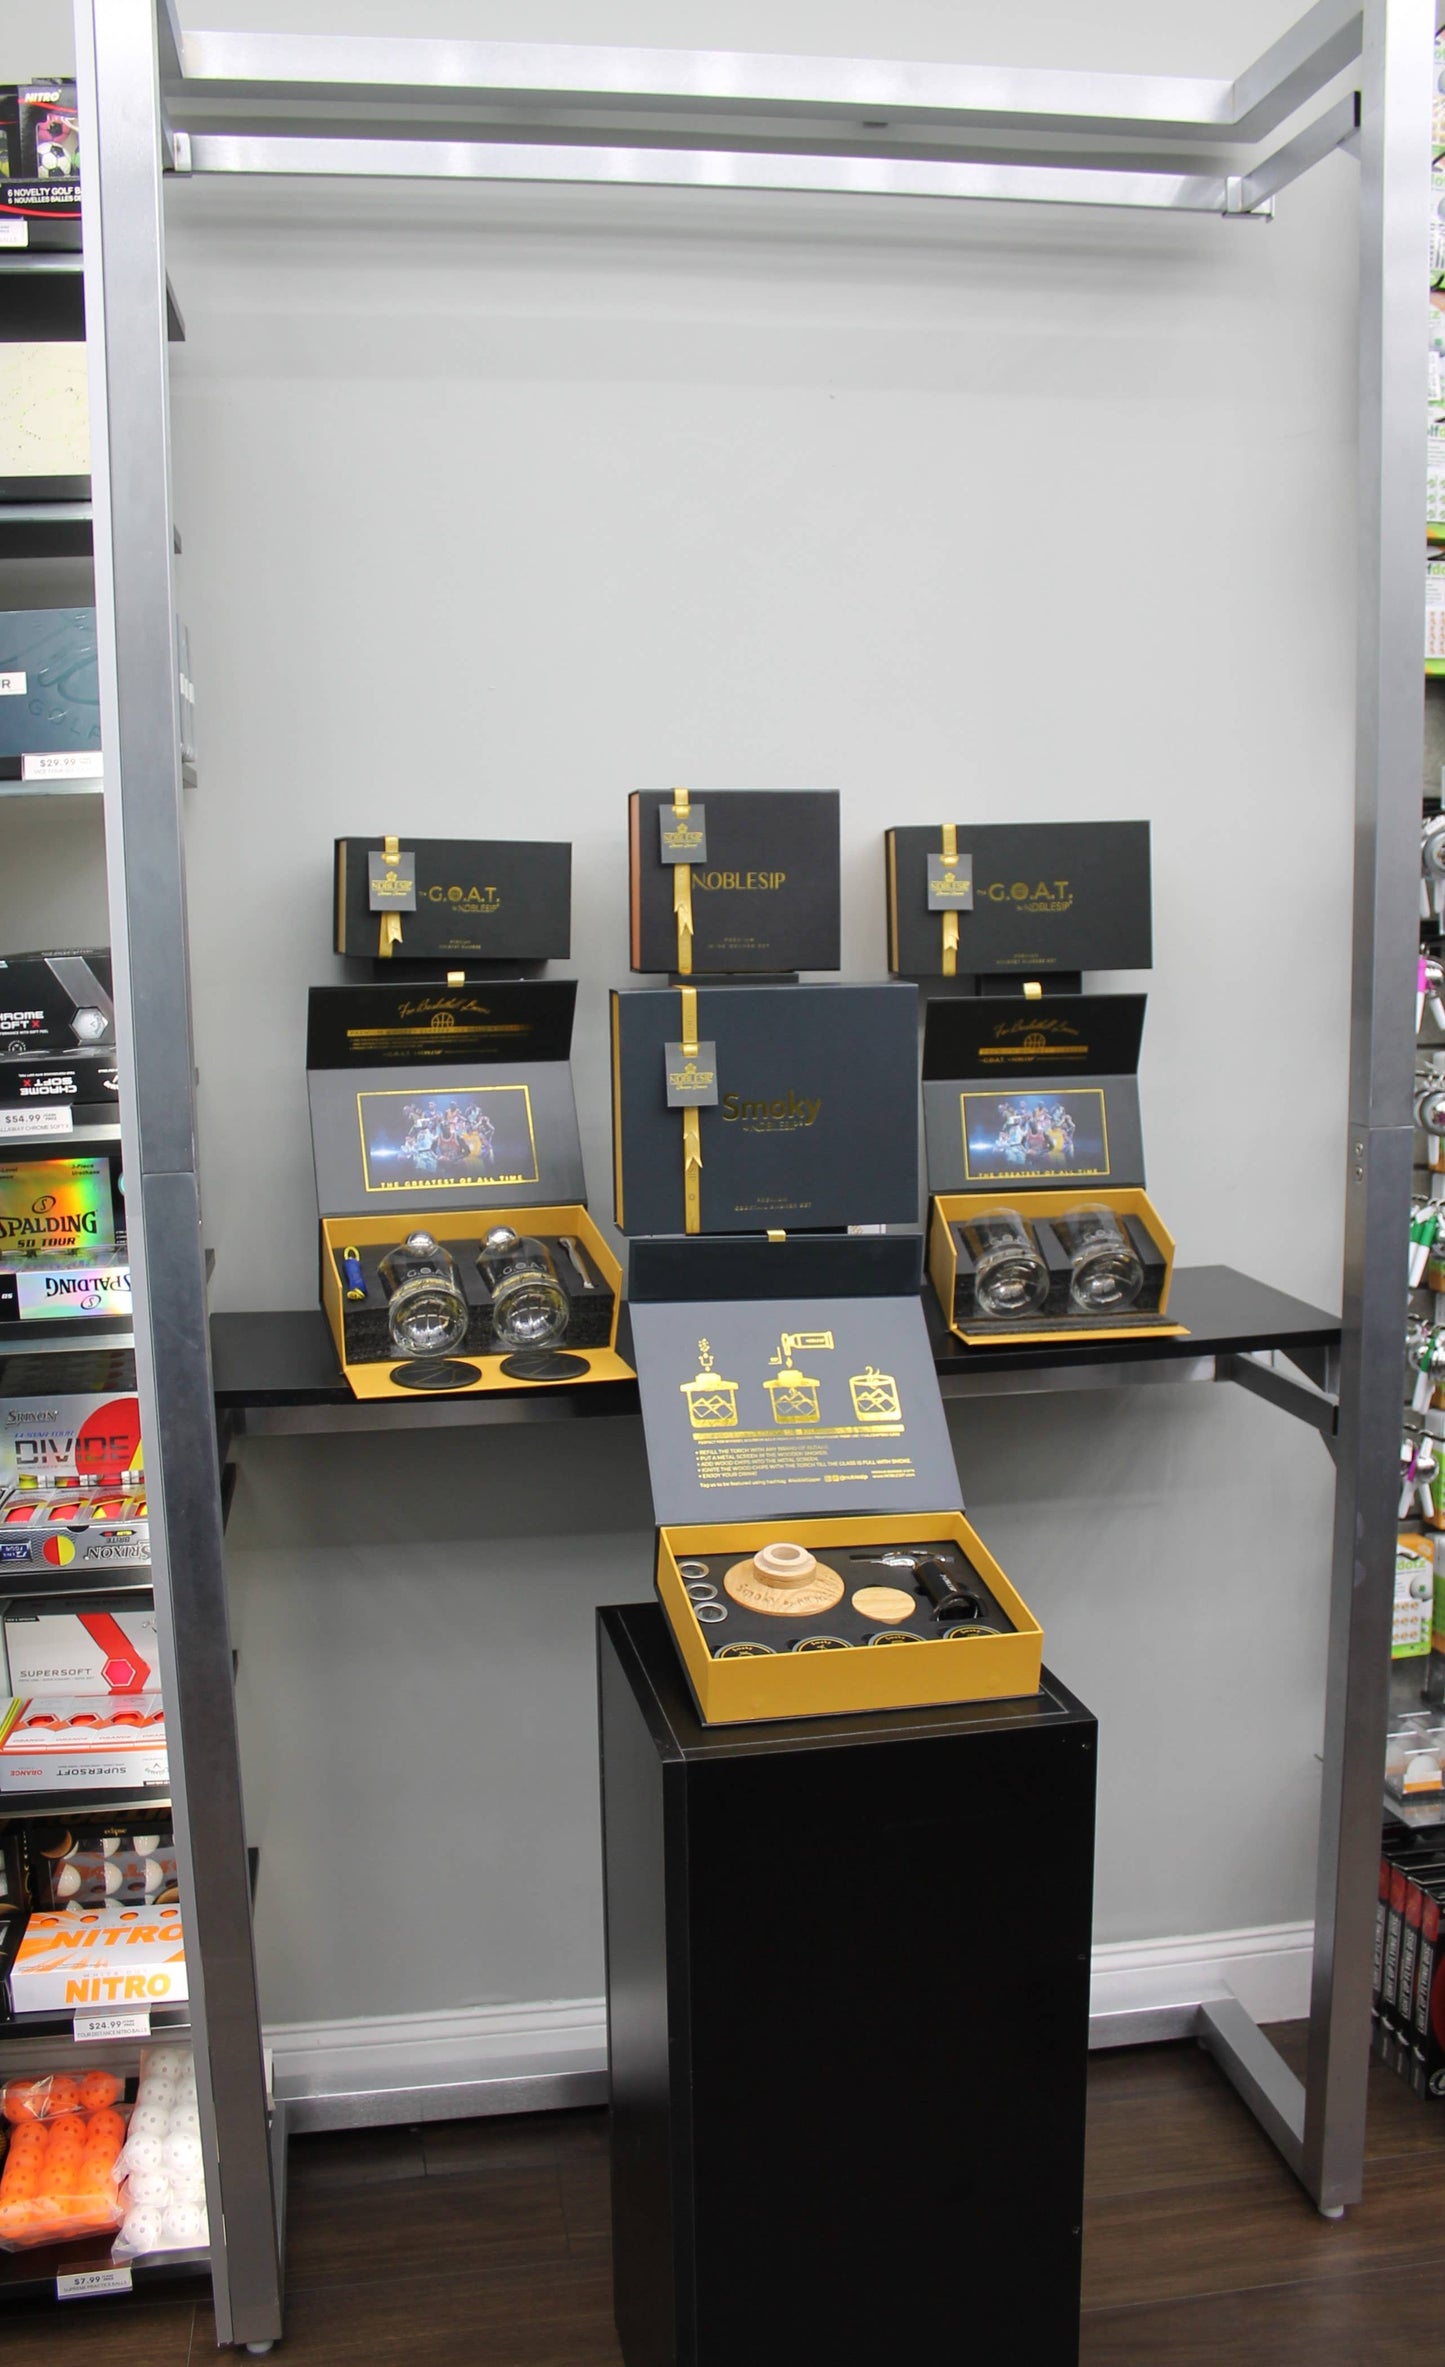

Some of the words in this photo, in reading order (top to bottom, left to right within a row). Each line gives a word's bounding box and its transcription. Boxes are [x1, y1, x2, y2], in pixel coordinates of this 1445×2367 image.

[24, 92, 59, 103] NITRO
[7, 189, 13, 197] 6
[14, 187, 51, 197] NOVELTY
[51, 186, 73, 196] GOLF
[7, 197, 13, 205] 6
[14, 196, 49, 204] NOUVELLES
[50, 195, 73, 203] BALLES
[40, 759, 76, 768] $29.99
[692, 871, 786, 891] NOBLESIP
[428, 886, 500, 902] G.O.A.T.
[988, 881, 1073, 901] G.O.A.T.
[22, 1078, 32, 1087] X
[34, 1077, 73, 1087] SOFT
[20, 1084, 78, 1096] CHROME
[722, 1089, 822, 1127] Smoky
[5, 1114, 41, 1124] $54.99
[999, 1170, 1041, 1178] GREATEST
[1045, 1169, 1056, 1177] OF
[1060, 1168, 1075, 1176] ALL
[1078, 1167, 1098, 1175] TIME
[381, 1181, 399, 1189] THE
[404, 1178, 455, 1188] GREATEST
[459, 1177, 473, 1185] OF
[477, 1175, 495, 1183] ALL
[499, 1174, 524, 1182] TIME
[41, 1237, 77, 1248] TOUR
[6, 1410, 58, 1427] SRIXON
[15, 1435, 130, 1465] DIVIDE
[87, 1543, 151, 1560] SRIXON
[736, 1583, 779, 1604] Smoky
[20, 1668, 92, 1678] SUPERSOFT
[56, 1767, 127, 1776] SUPERSOFT
[50, 1924, 183, 1949] NITRO
[65, 1973, 171, 2004] NITRO
[89, 2021, 121, 2030] $24.99
[74, 2276, 100, 2285] $7.99
